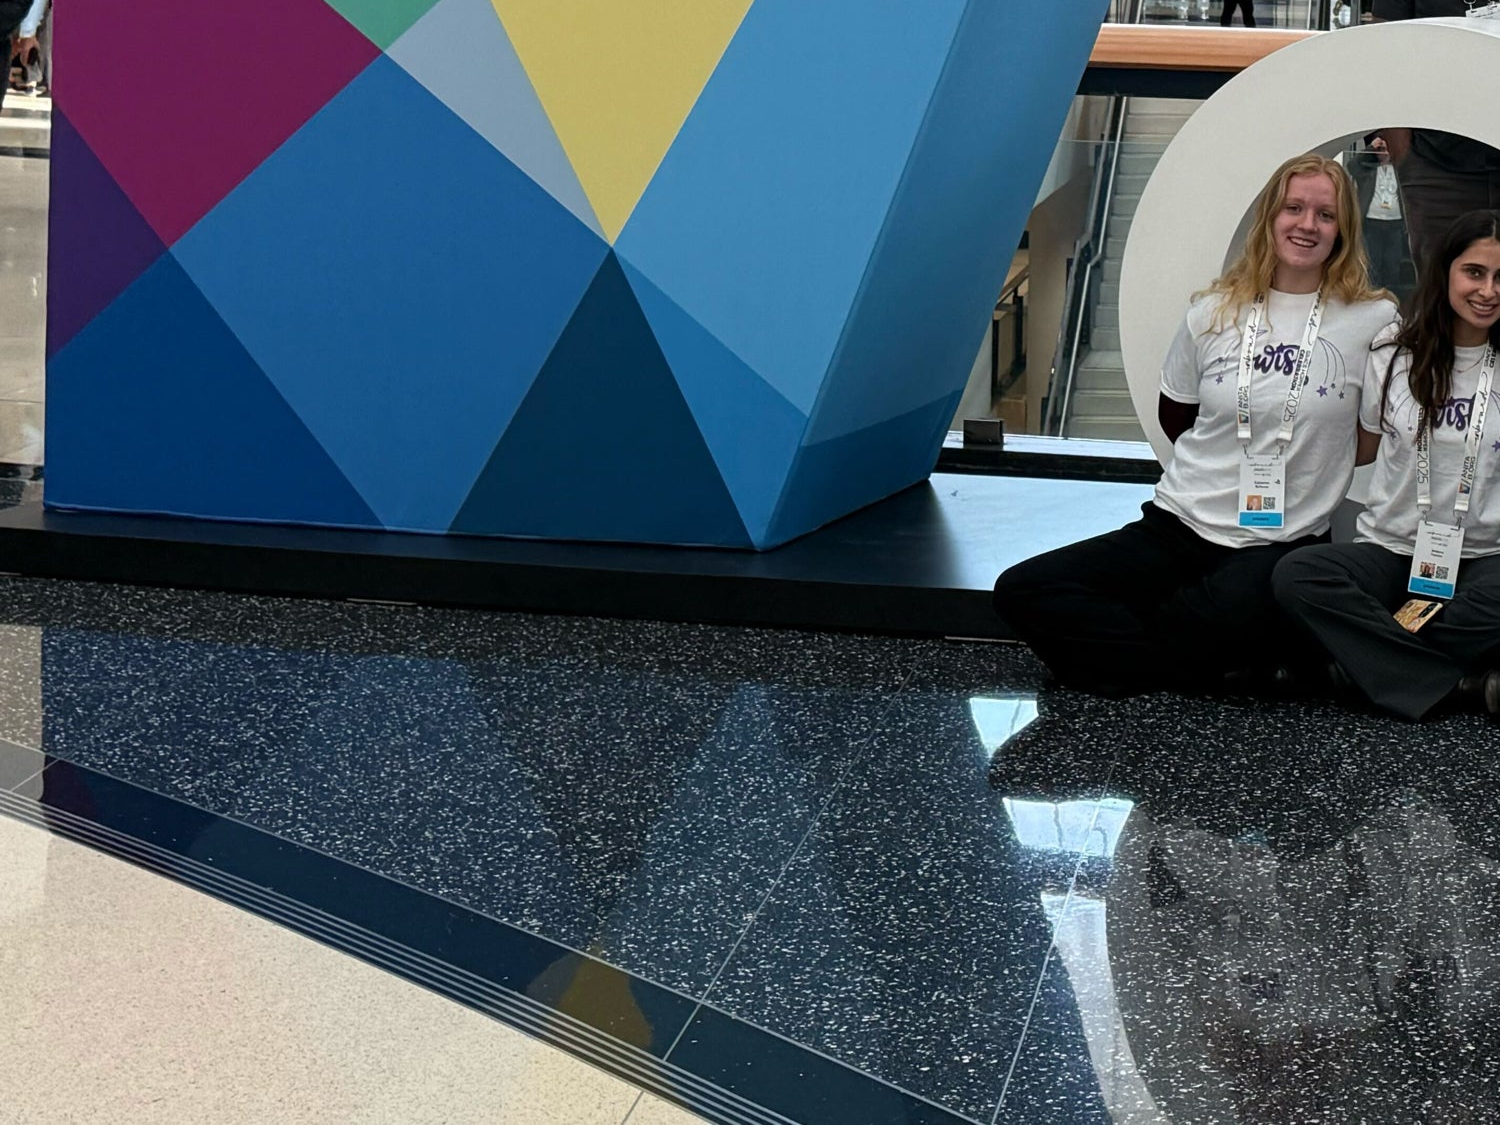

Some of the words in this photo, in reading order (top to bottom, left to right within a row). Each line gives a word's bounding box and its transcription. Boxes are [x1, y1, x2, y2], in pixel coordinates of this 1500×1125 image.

[1253, 342, 1309, 386] wis
[1283, 393, 1300, 422] 2025
[1417, 453, 1429, 484] 2025
